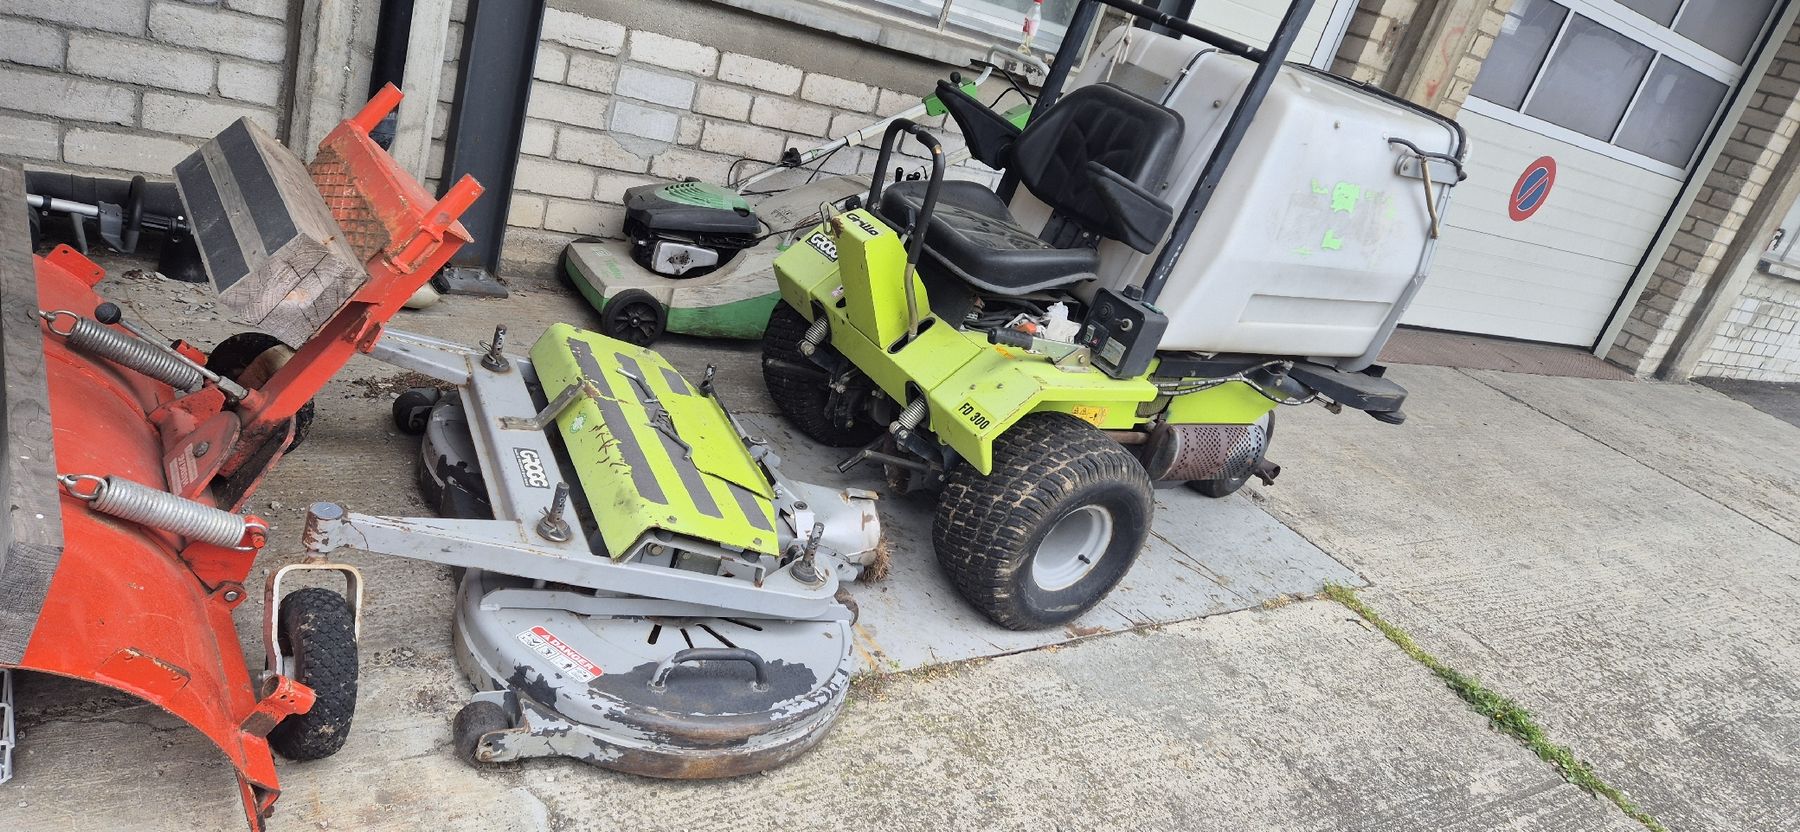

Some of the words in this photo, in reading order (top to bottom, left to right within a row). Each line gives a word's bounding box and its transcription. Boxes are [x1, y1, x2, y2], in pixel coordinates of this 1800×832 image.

[846, 213, 879, 236] Grillo
[958, 402, 974, 416] FD
[970, 412, 990, 430] 300
[550, 638, 595, 671] DANGER
